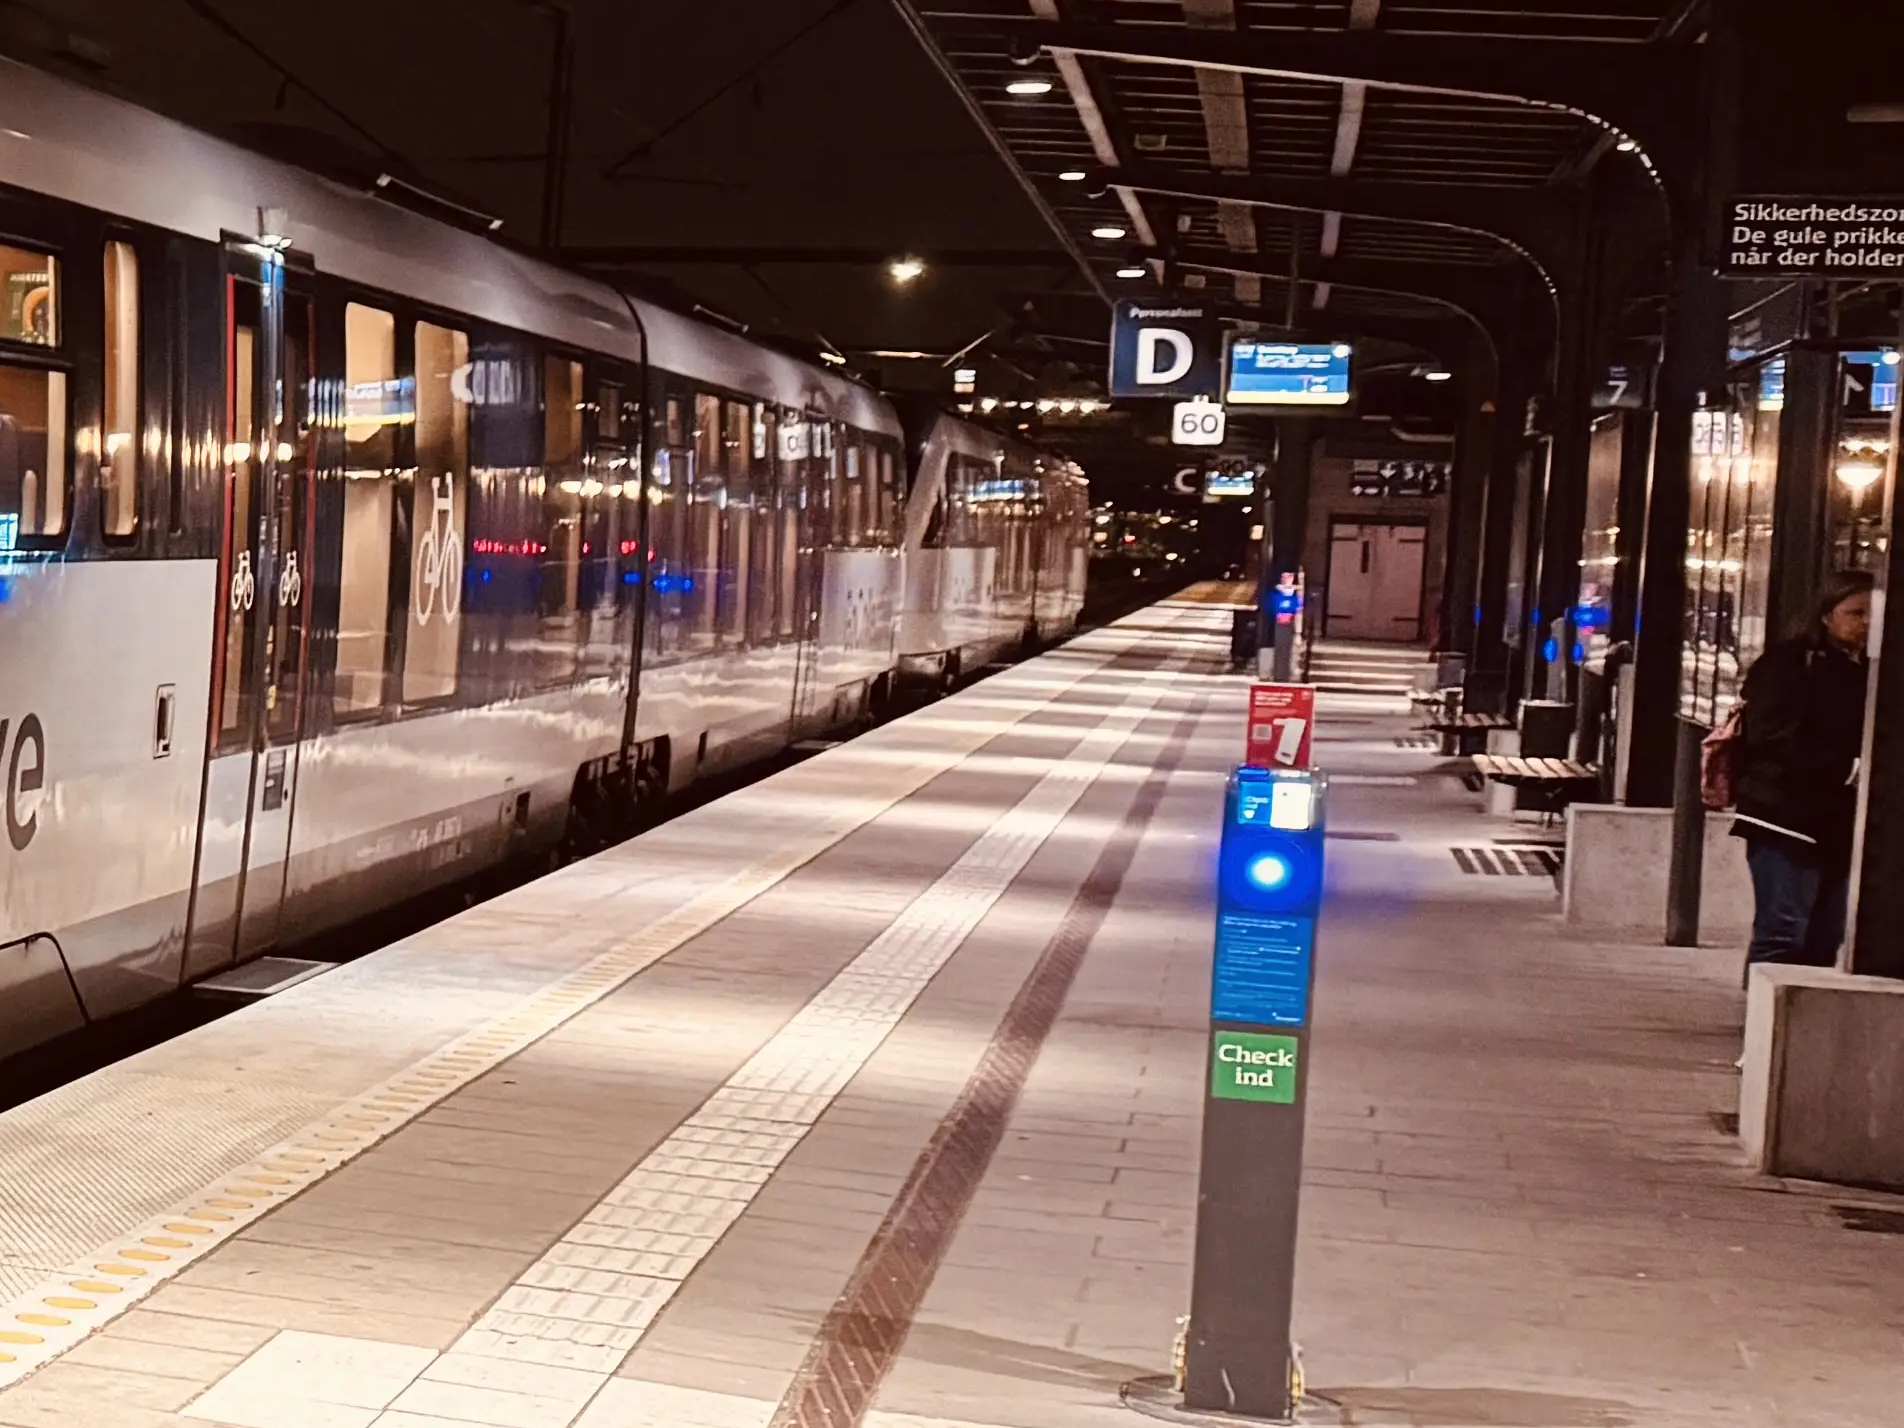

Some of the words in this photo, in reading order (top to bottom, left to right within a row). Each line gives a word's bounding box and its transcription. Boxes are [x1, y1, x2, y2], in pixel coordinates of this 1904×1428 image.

[1732, 226, 1766, 244] De
[1773, 226, 1827, 247] gule
[1730, 247, 1772, 265] når
[1777, 248, 1820, 266] der
[1136, 328, 1193, 384] D
[1608, 380, 1629, 405] 7
[1181, 413, 1218, 434] 60
[1174, 468, 1197, 492] C
[1218, 1043, 1294, 1067] Check
[1235, 1067, 1274, 1087] ind
